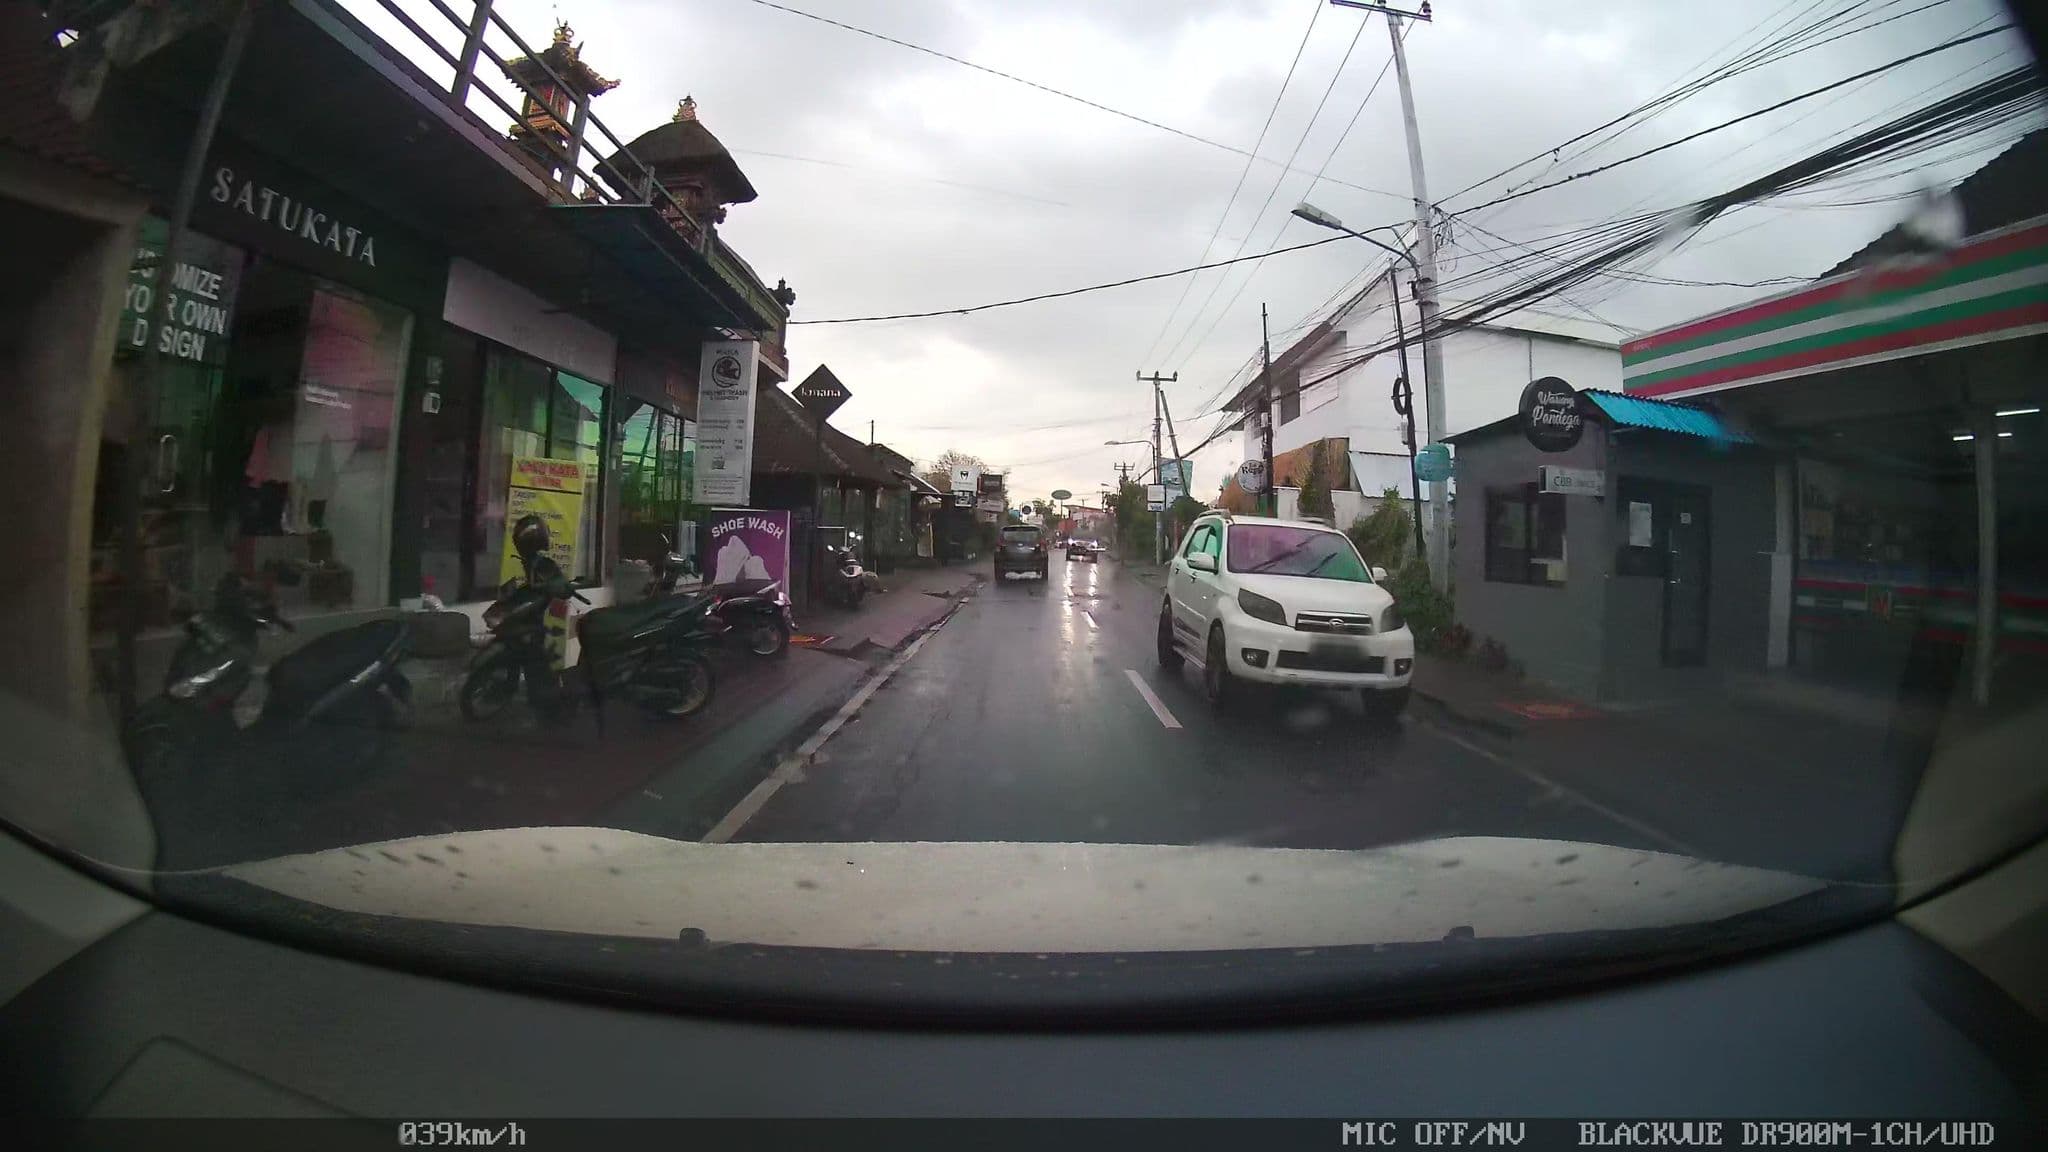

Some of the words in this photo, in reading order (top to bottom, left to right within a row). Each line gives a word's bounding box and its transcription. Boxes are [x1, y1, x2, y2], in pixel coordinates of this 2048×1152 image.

[210, 167, 377, 268] SATUKATA
[124, 283, 178, 321] YOR
[181, 299, 227, 335] OWN
[131, 317, 206, 362] DSIGN
[1532, 405, 1580, 431] Pandega
[711, 517, 745, 538] SHOE
[748, 517, 785, 539] WASH
